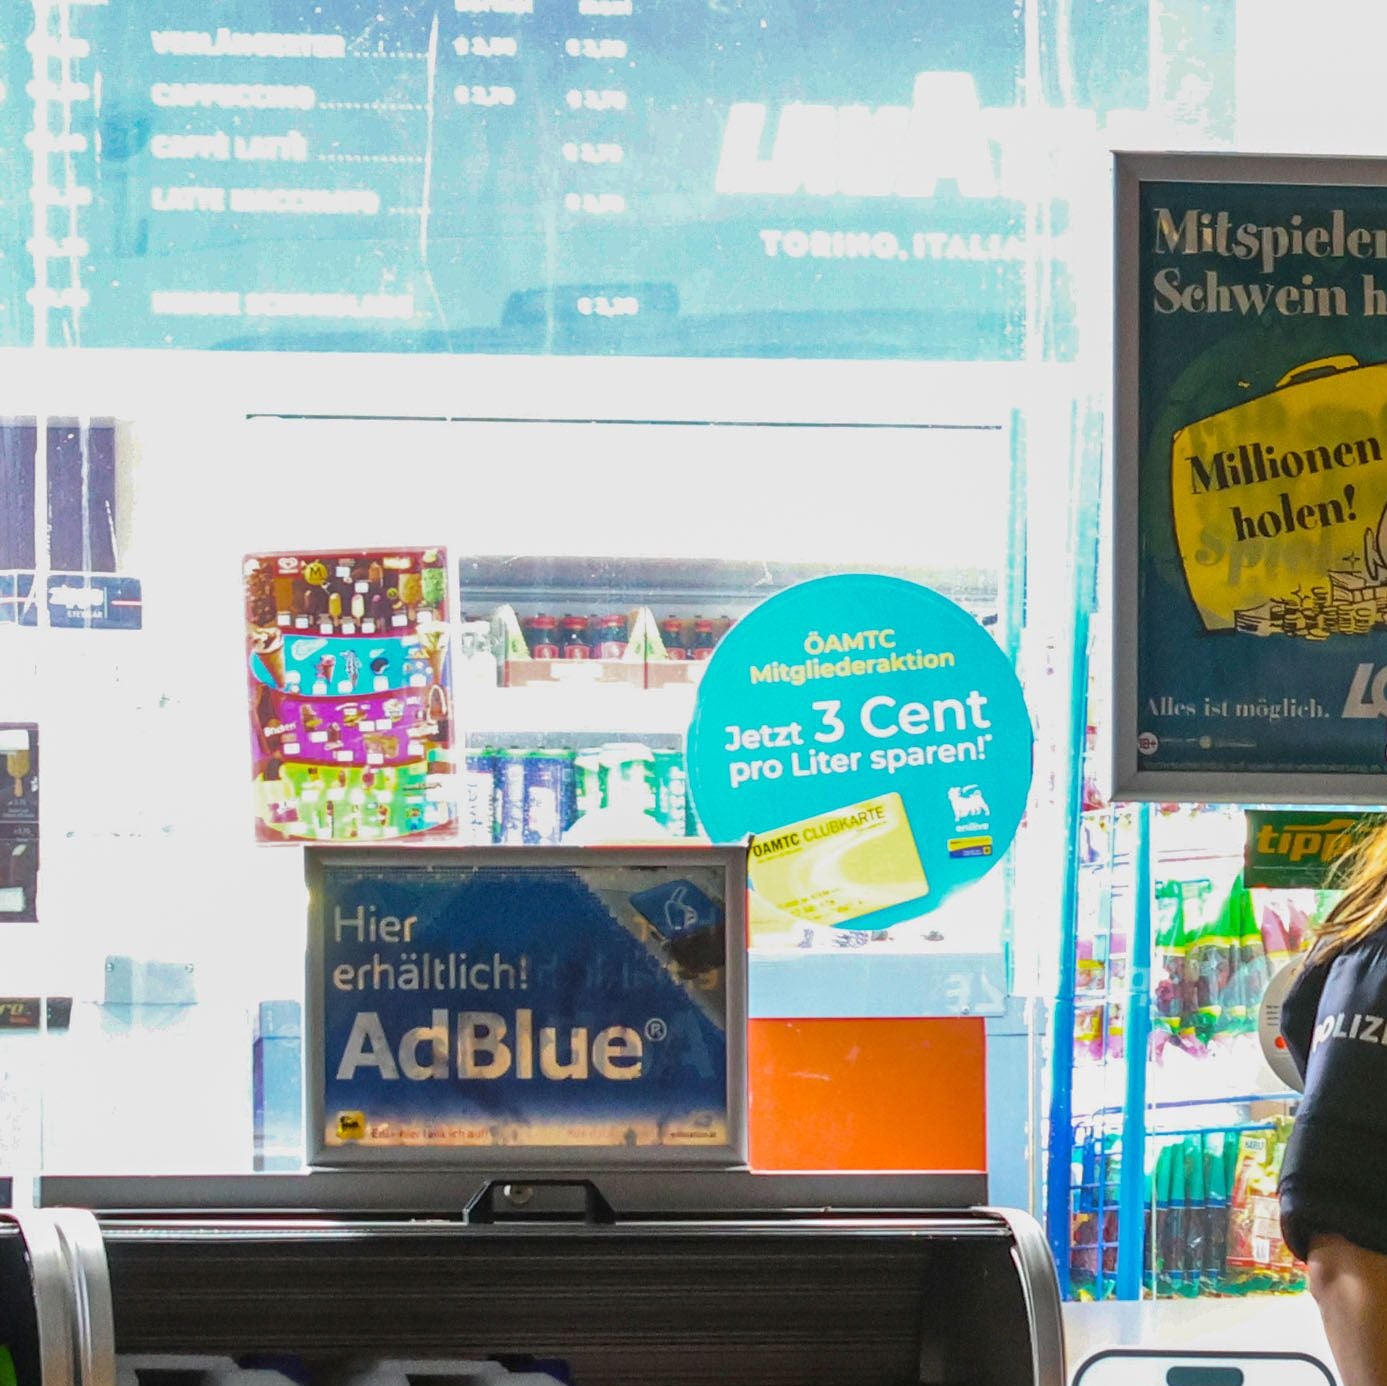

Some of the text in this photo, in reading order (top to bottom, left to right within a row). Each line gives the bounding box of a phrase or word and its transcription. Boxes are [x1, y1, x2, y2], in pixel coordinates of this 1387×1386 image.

[760, 230, 908, 260] TORINO,
[1153, 270, 1348, 318] Schwein
[1185, 436, 1383, 495] Millionen
[1230, 484, 1357, 542] holen!
[804, 629, 896, 655] ÖAMTC
[750, 651, 955, 686] Mitgliederaktion
[725, 691, 991, 751] Jetzt 3 Cent
[1148, 697, 1330, 720] Alles ist möglich.
[730, 757, 783, 788] pro
[791, 750, 861, 777] Liter
[803, 806, 885, 842] CLUBKARTE
[333, 905, 418, 943] Hier
[332, 953, 528, 991] erhältlich!
